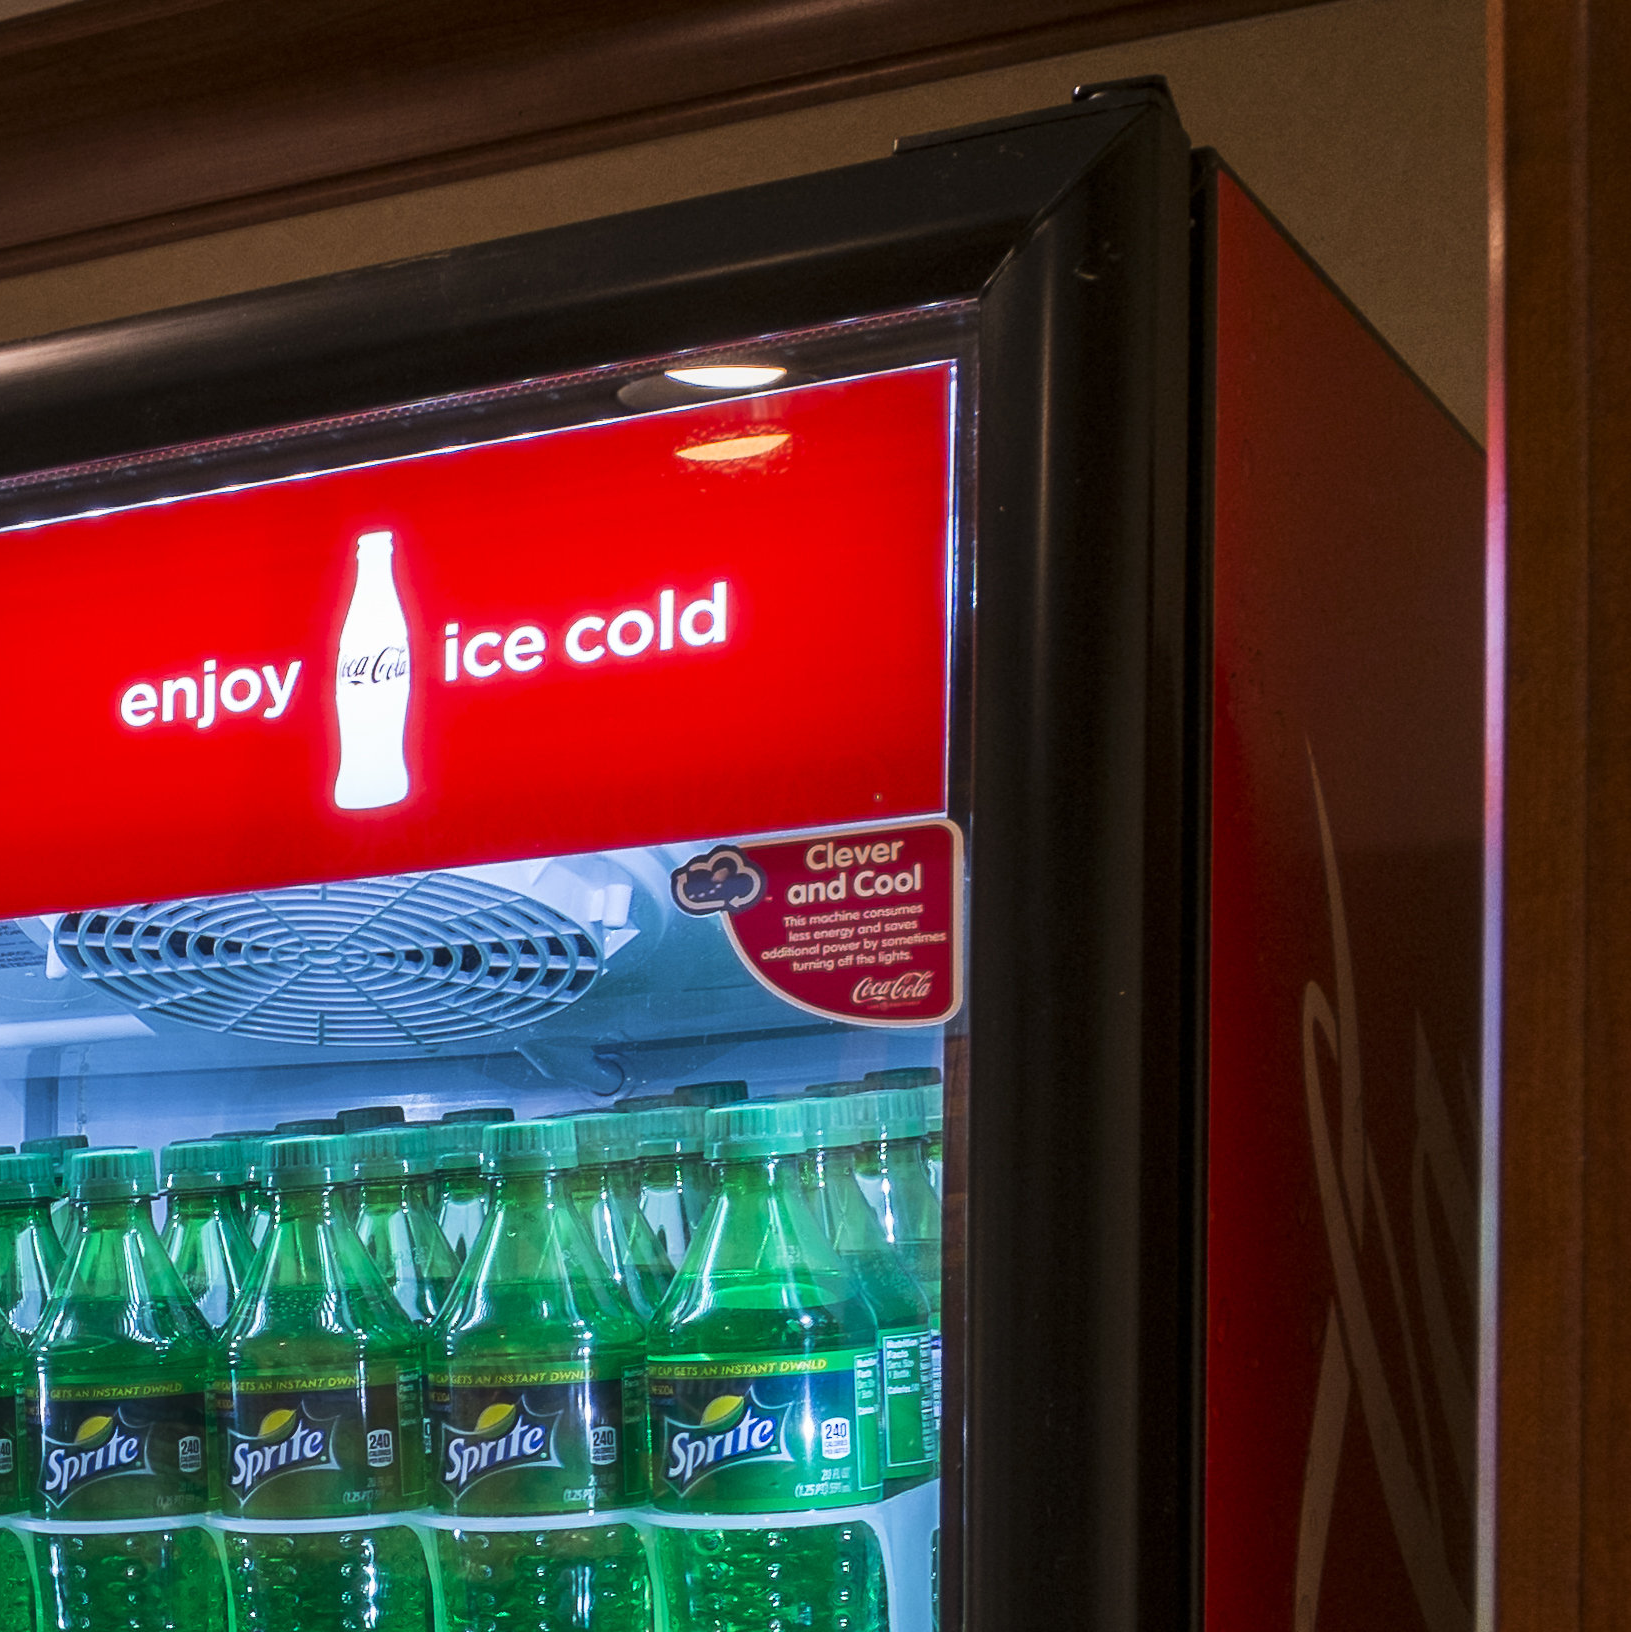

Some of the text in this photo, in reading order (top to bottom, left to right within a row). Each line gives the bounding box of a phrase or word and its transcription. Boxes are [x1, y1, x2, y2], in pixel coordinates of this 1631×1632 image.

[119, 581, 728, 729] enjoy ice cold
[806, 840, 904, 871] Clever
[787, 863, 922, 906] and Cool
[784, 903, 924, 928] This machine consumes
[788, 918, 918, 944] less energy and saves
[761, 931, 947, 961] additional power by sometimes
[792, 949, 913, 973] turning off the lights.
[851, 971, 935, 1005] Coca-Cola
[452, 1372, 547, 1385] GETS AN INSTANT
[674, 1359, 827, 1377] GETS AN INSTANT DWNLD
[50, 1383, 183, 1398] GETS AN INSTANT DWNLD
[258, 1378, 325, 1390] AN INSTANT
[369, 1433, 391, 1450] 240
[592, 1430, 614, 1446] 240
[825, 1423, 847, 1439] 240
[180, 1440, 200, 1455] 240
[231, 1419, 324, 1492] Sprite
[445, 1414, 545, 1487] Sprite
[668, 1406, 774, 1484] Sprite
[45, 1426, 139, 1495] Sprite
